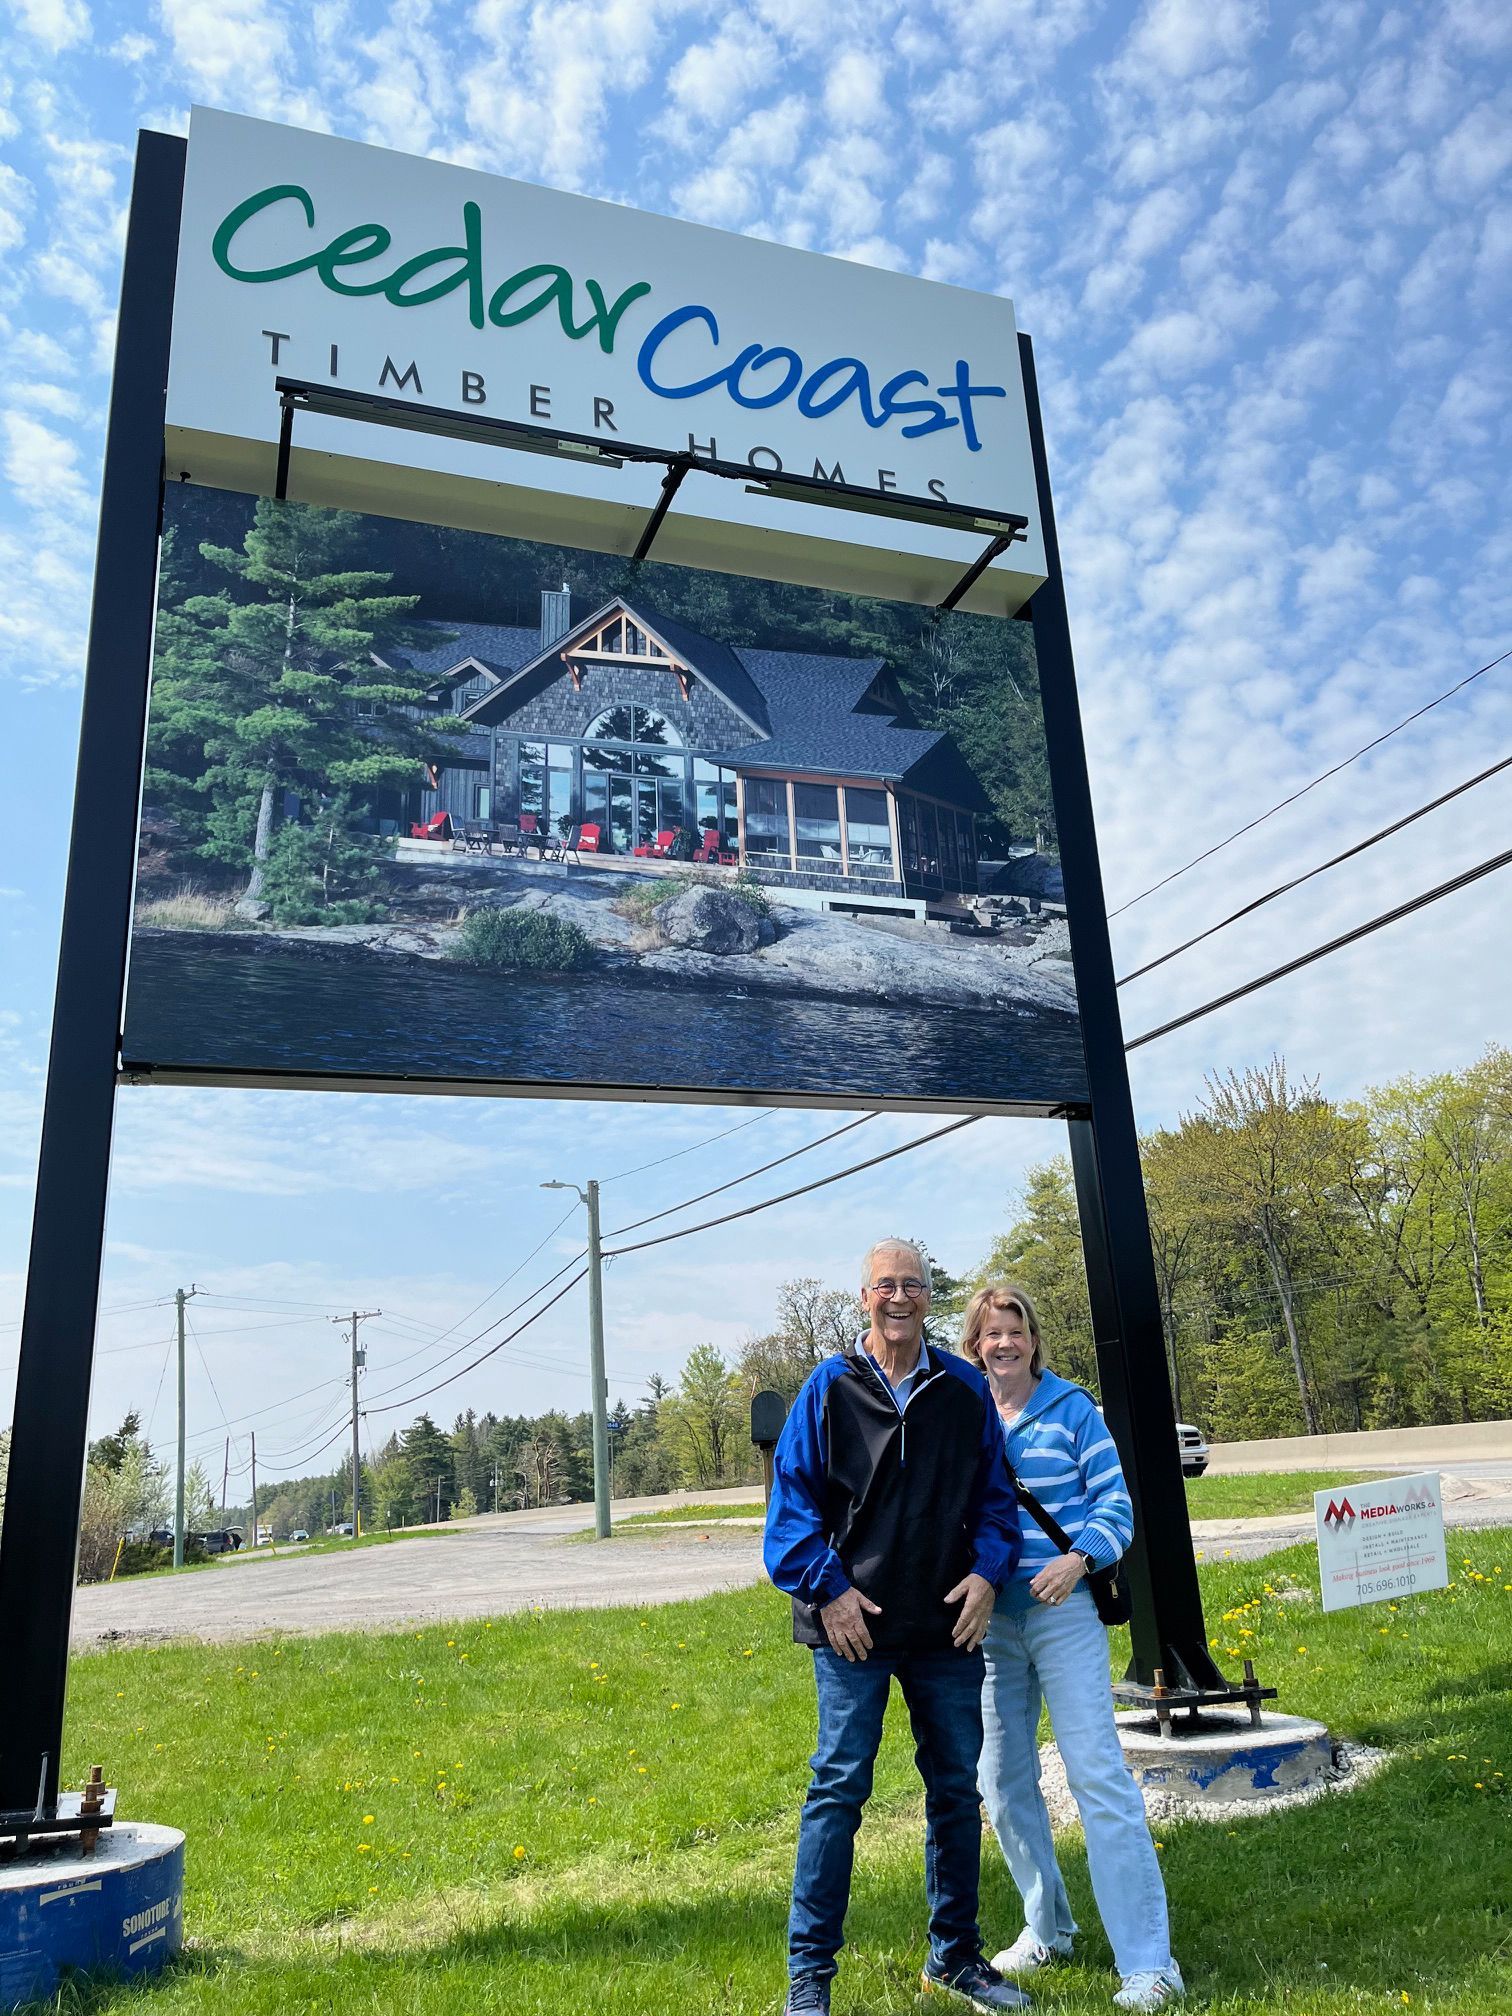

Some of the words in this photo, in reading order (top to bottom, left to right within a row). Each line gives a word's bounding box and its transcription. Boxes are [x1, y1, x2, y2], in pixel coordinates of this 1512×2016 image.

[262, 330, 618, 431] TIMBER
[1389, 1543, 1420, 1553] WHOLESALE
[1391, 1533, 1428, 1544] MAINTENANCE
[1332, 1573, 1354, 1583] Making
[1379, 1564, 1391, 1574] look
[1392, 1561, 1406, 1573] good
[1356, 1573, 1416, 1596] 705.696.1010
